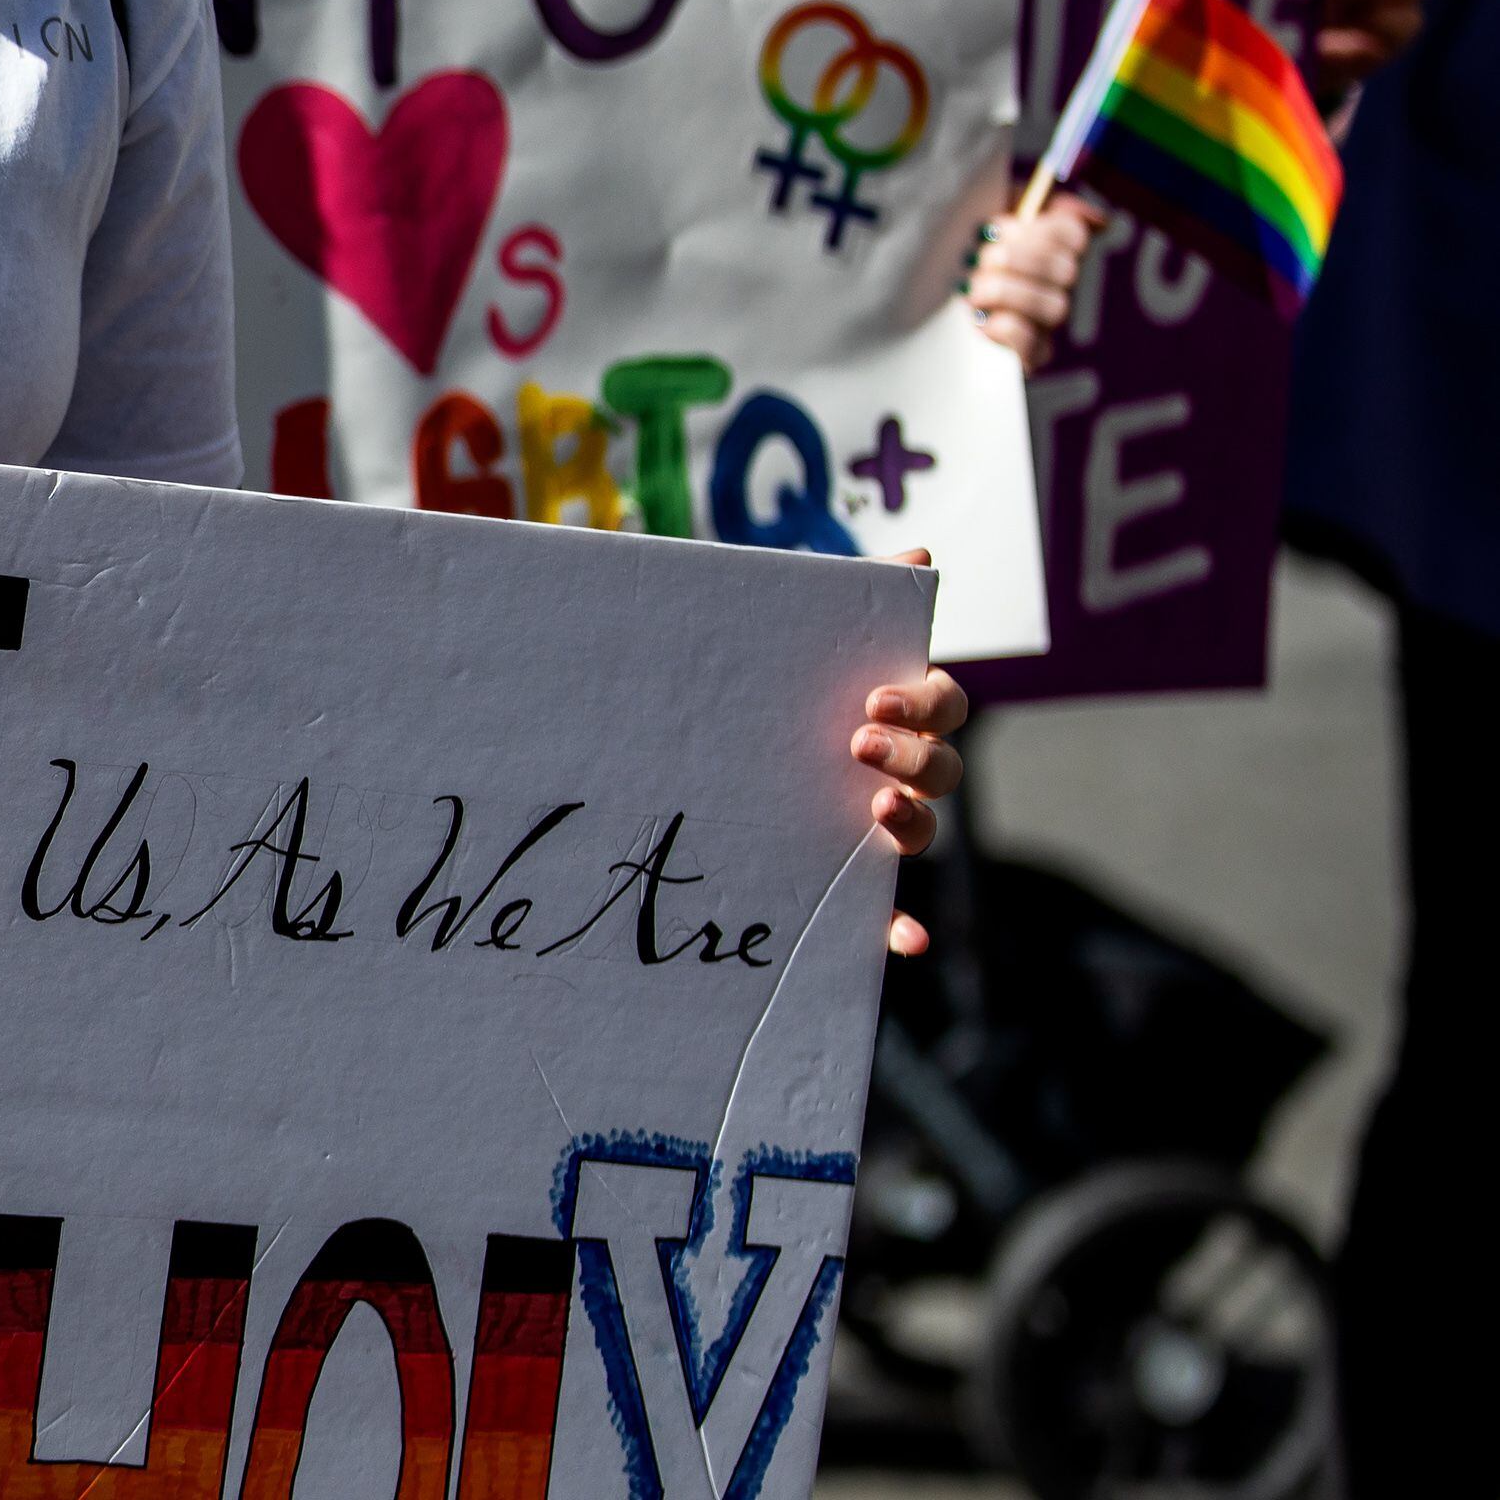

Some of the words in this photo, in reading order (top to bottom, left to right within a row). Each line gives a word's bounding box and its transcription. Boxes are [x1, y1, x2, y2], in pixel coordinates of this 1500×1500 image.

[179, 776, 355, 942] As
[394, 794, 585, 953] We
[536, 811, 773, 968] Are
